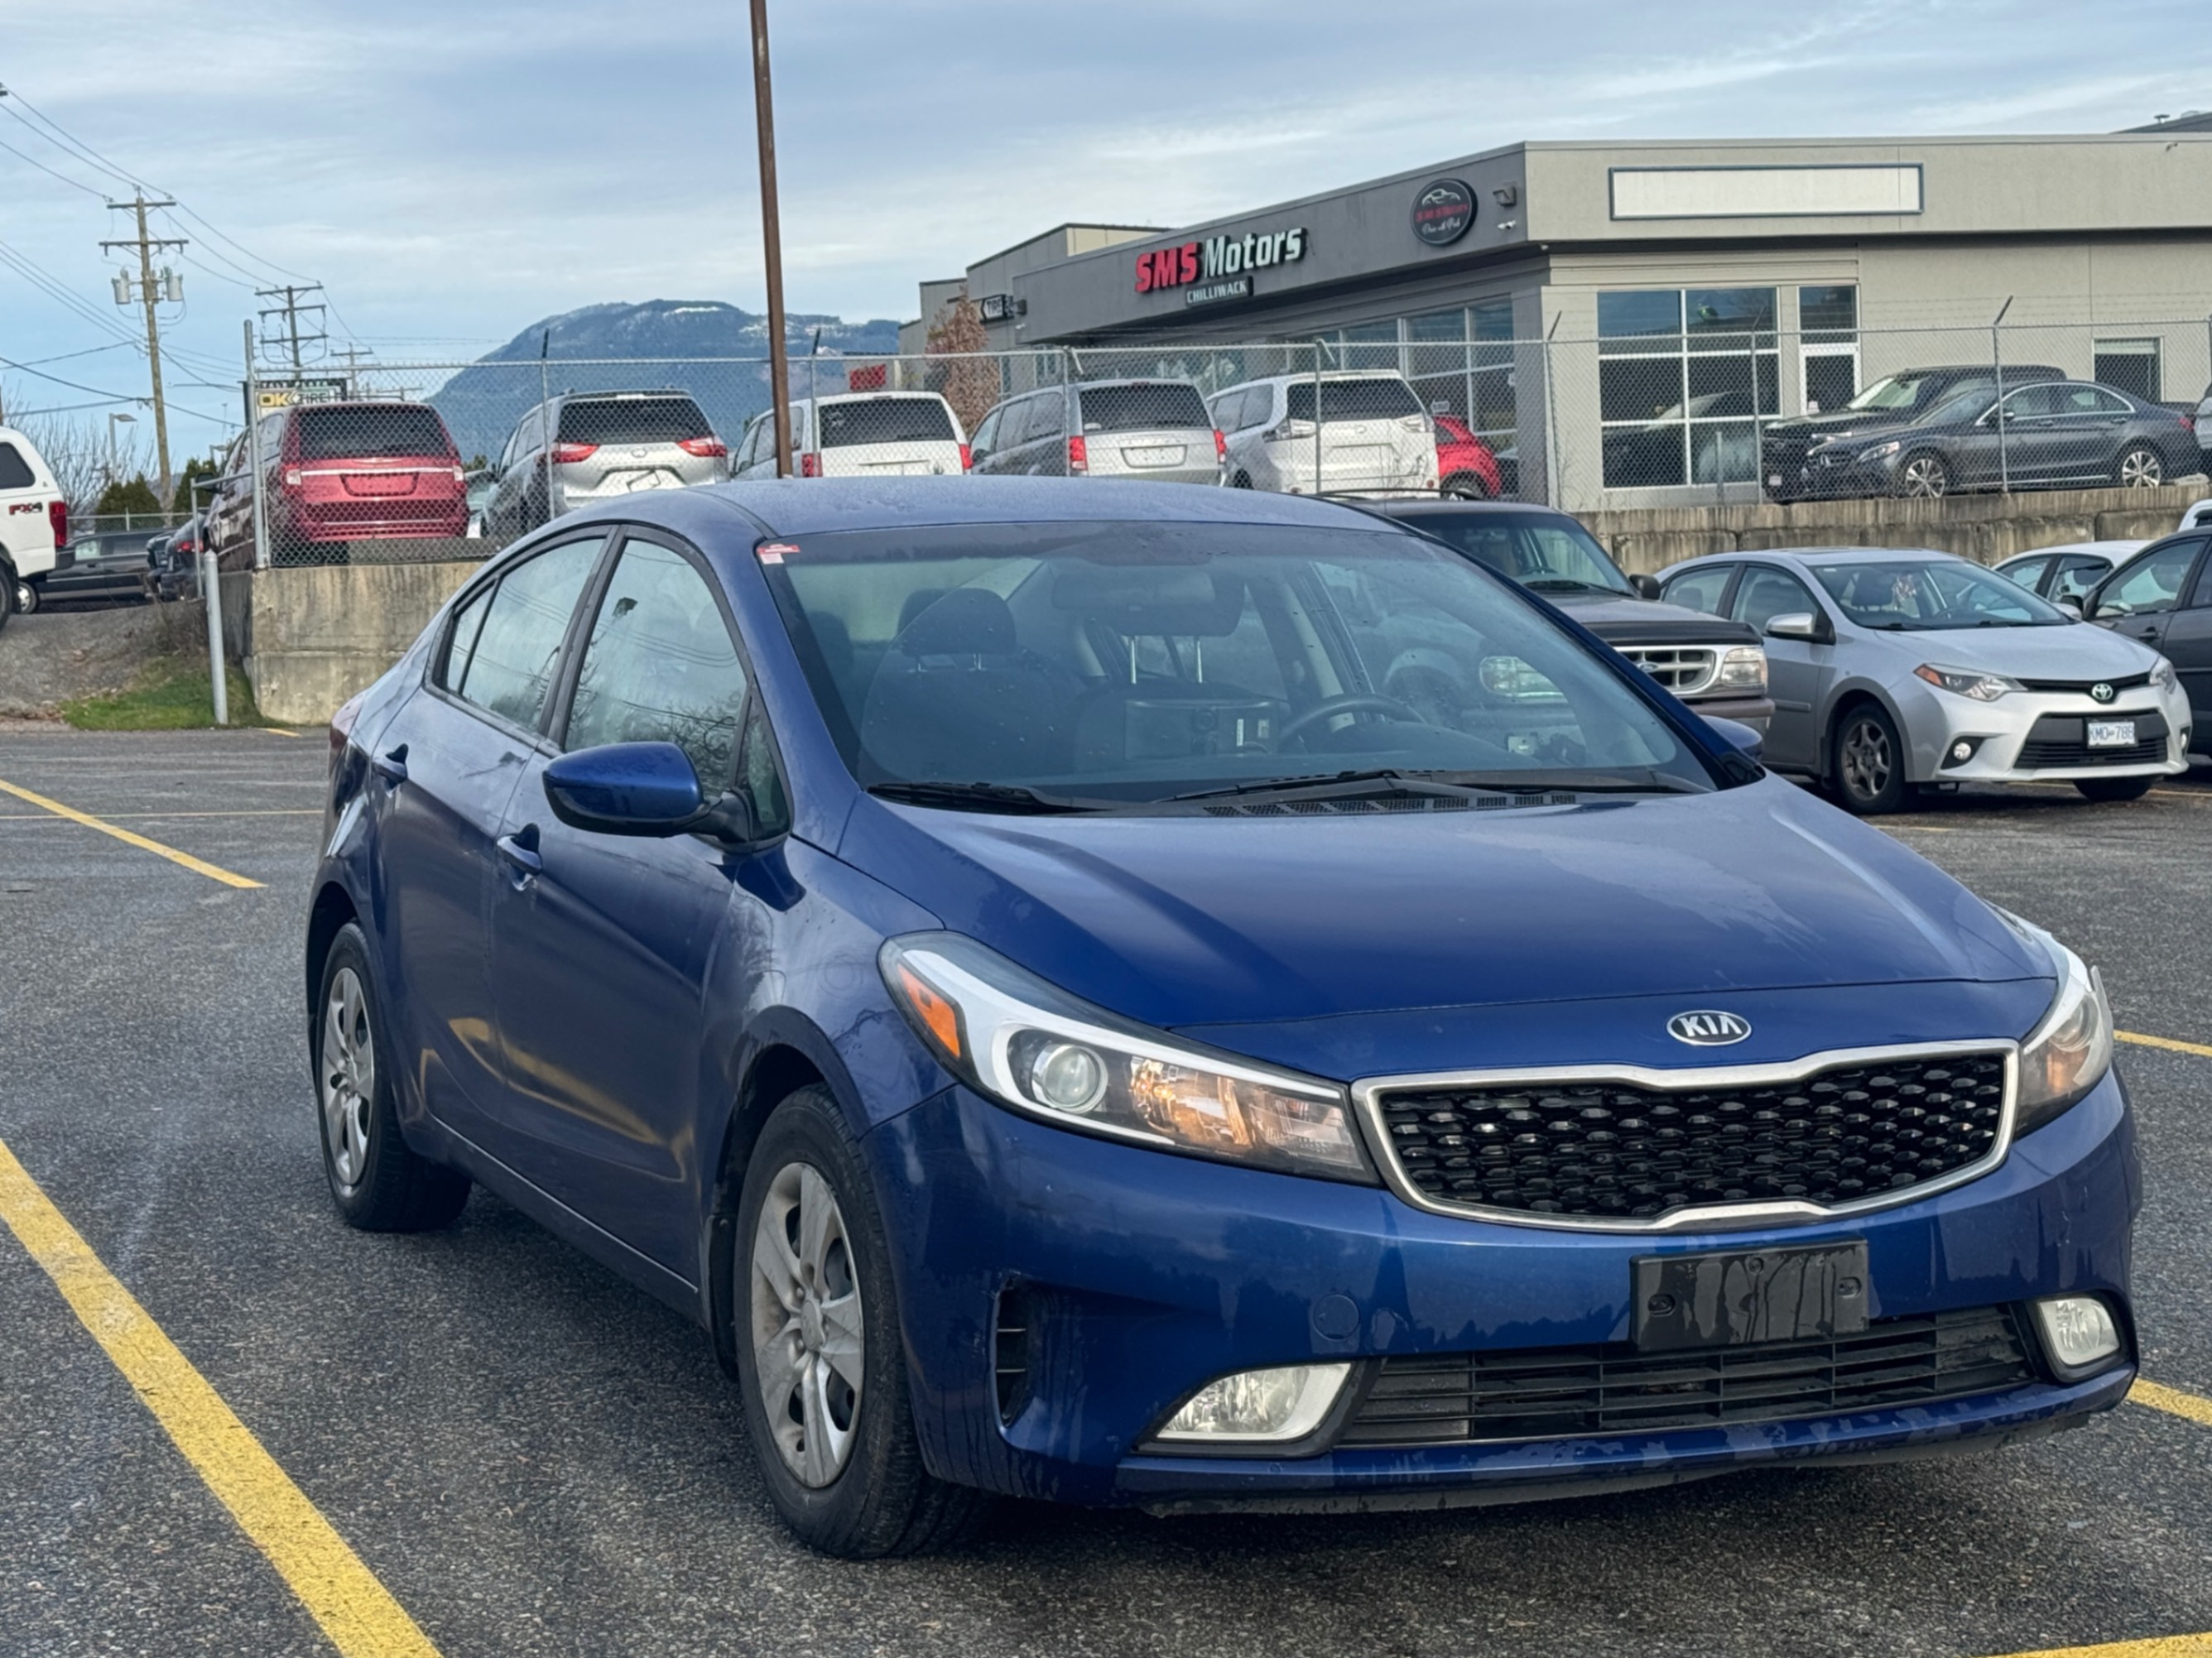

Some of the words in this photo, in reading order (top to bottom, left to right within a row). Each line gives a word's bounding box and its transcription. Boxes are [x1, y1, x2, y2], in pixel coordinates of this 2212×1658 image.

[1135, 242, 1197, 292] SMS
[1205, 228, 1302, 278] Motors
[1186, 280, 1247, 303] CHILLIWACK
[257, 392, 290, 407] OK
[298, 392, 329, 404] TIRE
[9, 502, 43, 515] FX4
[1678, 1015, 1743, 1037] KIA
